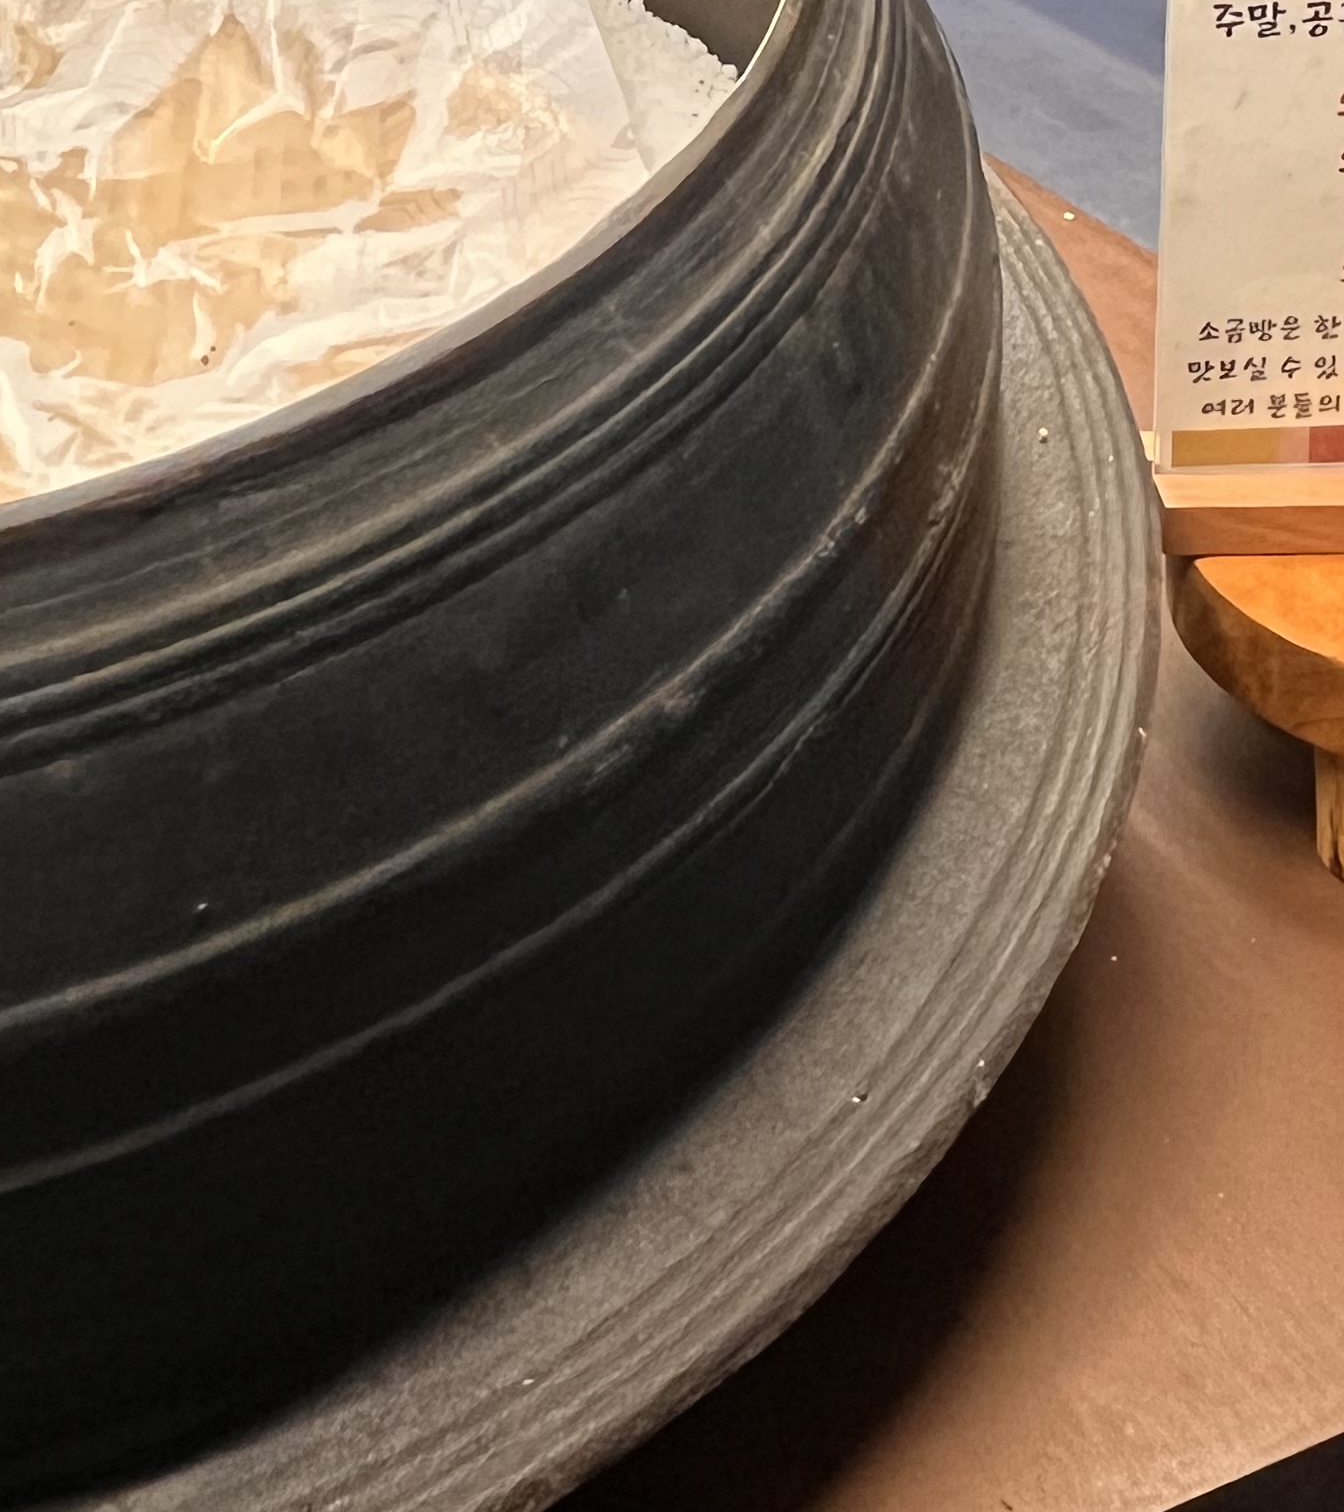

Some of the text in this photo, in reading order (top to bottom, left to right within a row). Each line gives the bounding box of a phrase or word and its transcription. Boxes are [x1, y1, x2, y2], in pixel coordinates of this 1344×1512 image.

[1198, 315, 1301, 344] 소금빵은
[1187, 355, 1268, 384] 맛보실
[1280, 355, 1302, 379] 수
[1200, 397, 1255, 417] 여러
[1267, 391, 1341, 419] 분들의
